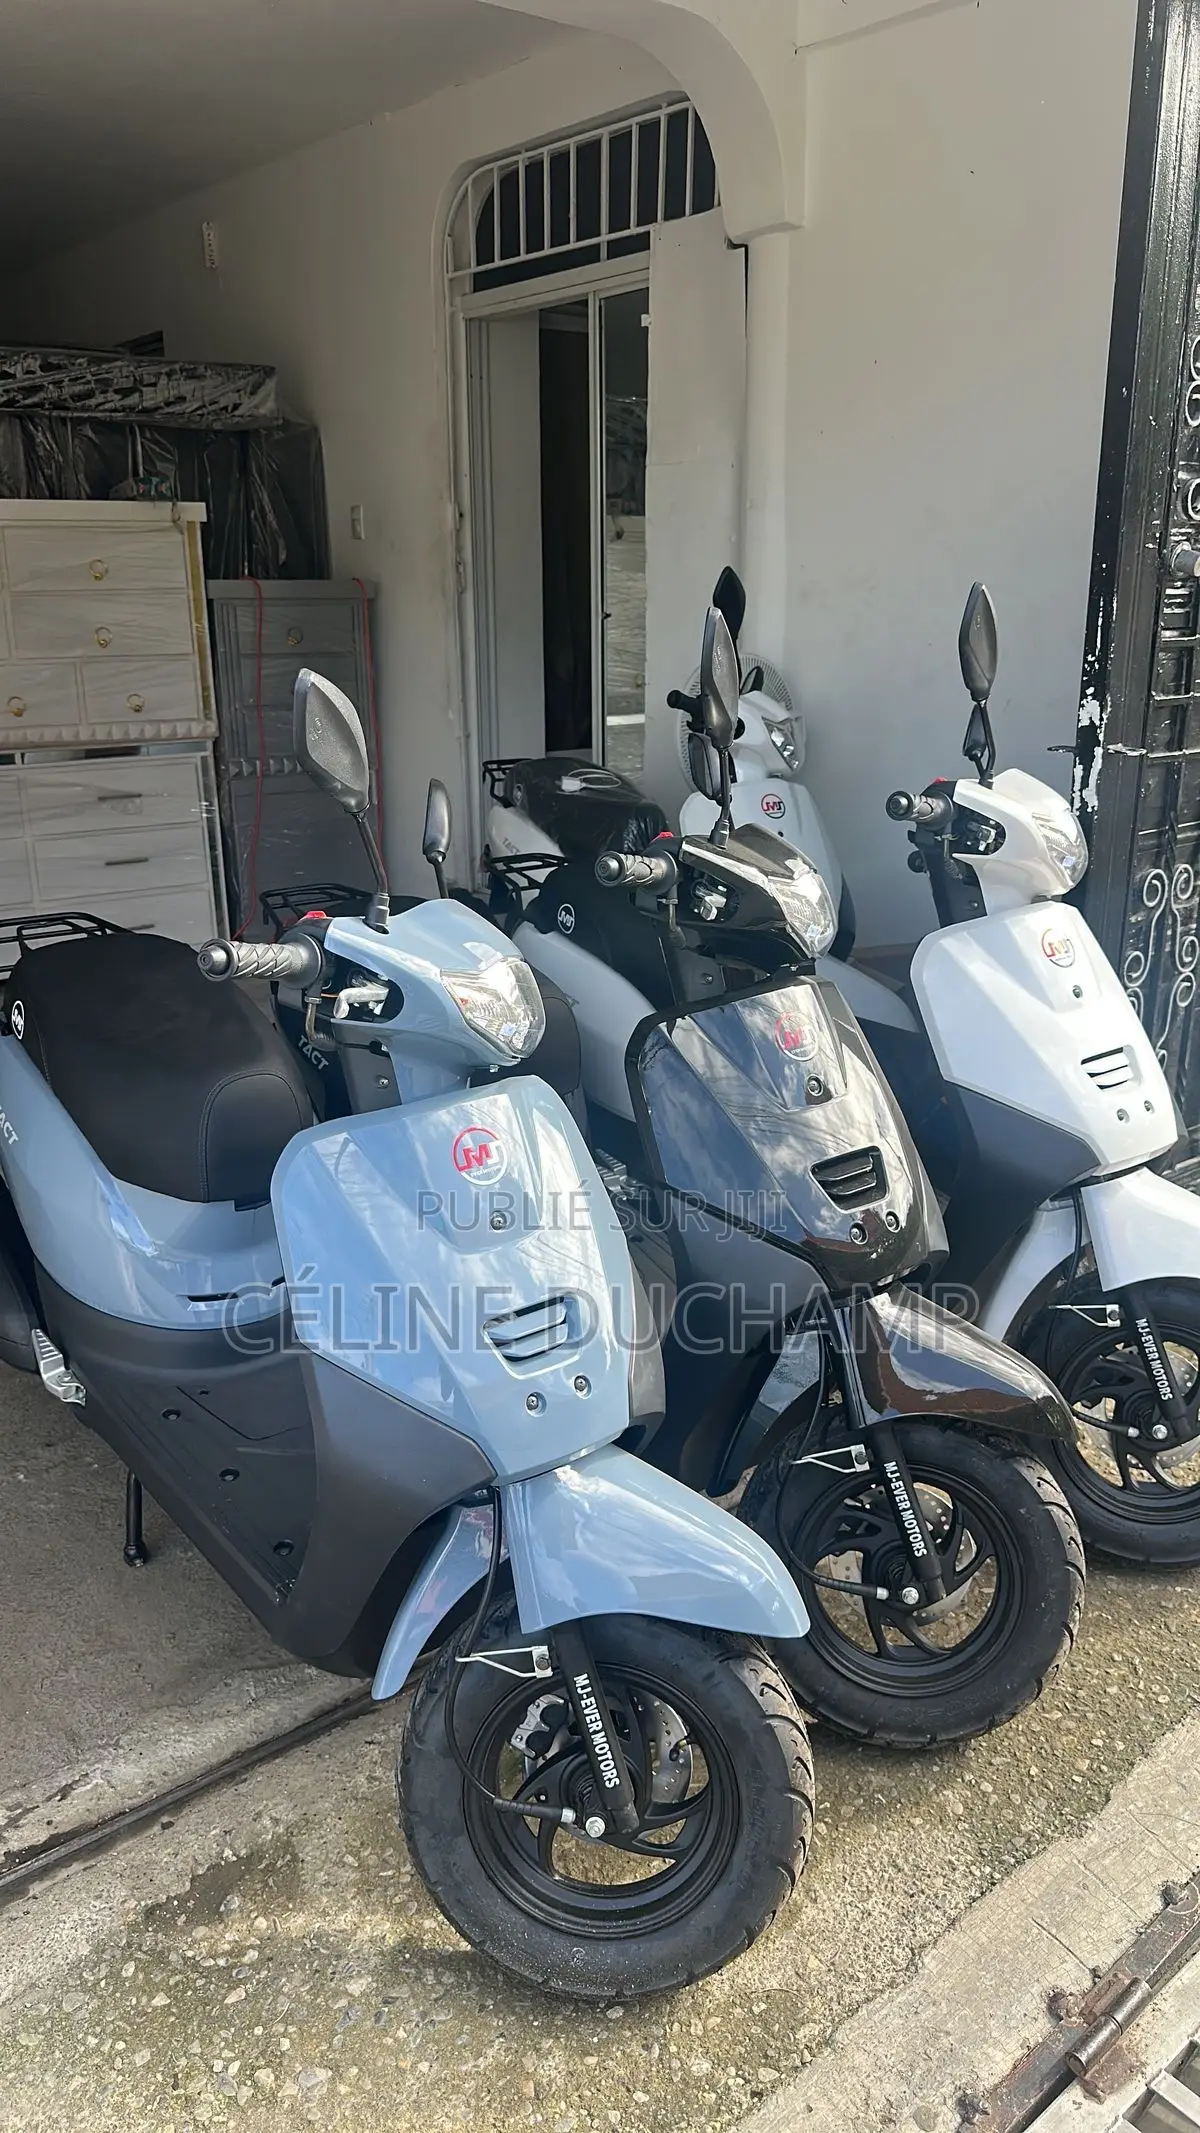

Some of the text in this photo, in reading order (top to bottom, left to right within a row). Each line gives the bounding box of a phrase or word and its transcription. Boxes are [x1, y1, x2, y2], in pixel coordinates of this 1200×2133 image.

[298, 1034, 330, 1070] TACT
[0, 1105, 19, 1145] ACT
[1135, 1318, 1173, 1401] MJ-EVER MOTORS
[883, 1461, 928, 1558] MJ-EVER MOTORS
[573, 1673, 620, 1789] MJ-EVER MOTORS
